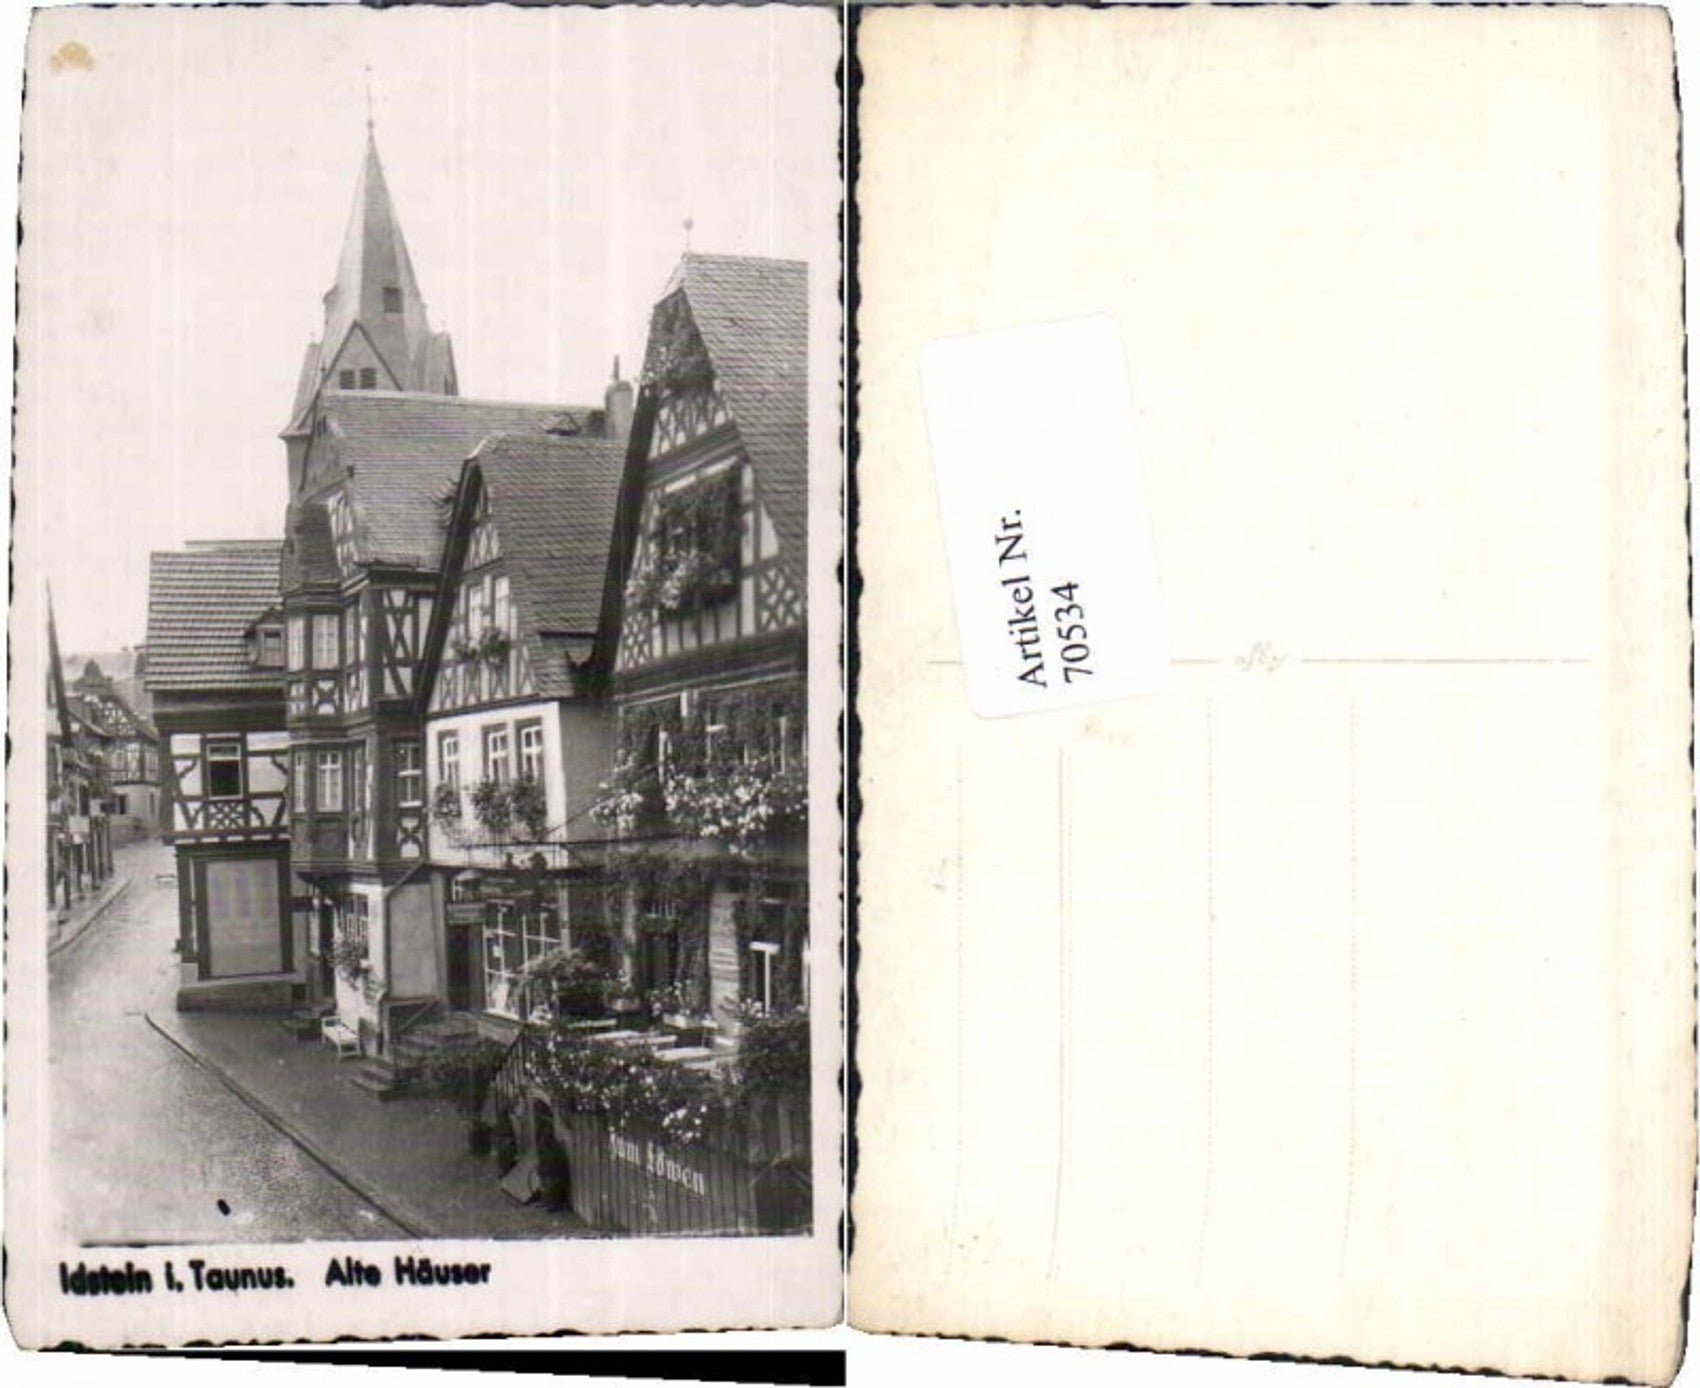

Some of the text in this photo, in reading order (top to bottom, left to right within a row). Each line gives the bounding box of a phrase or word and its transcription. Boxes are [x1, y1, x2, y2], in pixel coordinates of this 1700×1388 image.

[995, 509, 1047, 688] Artikel Nr.
[1050, 581, 1093, 684] 70534
[60, 1262, 152, 1295] Idstein
[188, 1259, 295, 1292] Taunus.
[325, 1257, 381, 1286] Alte
[395, 1256, 491, 1285] Häuser
